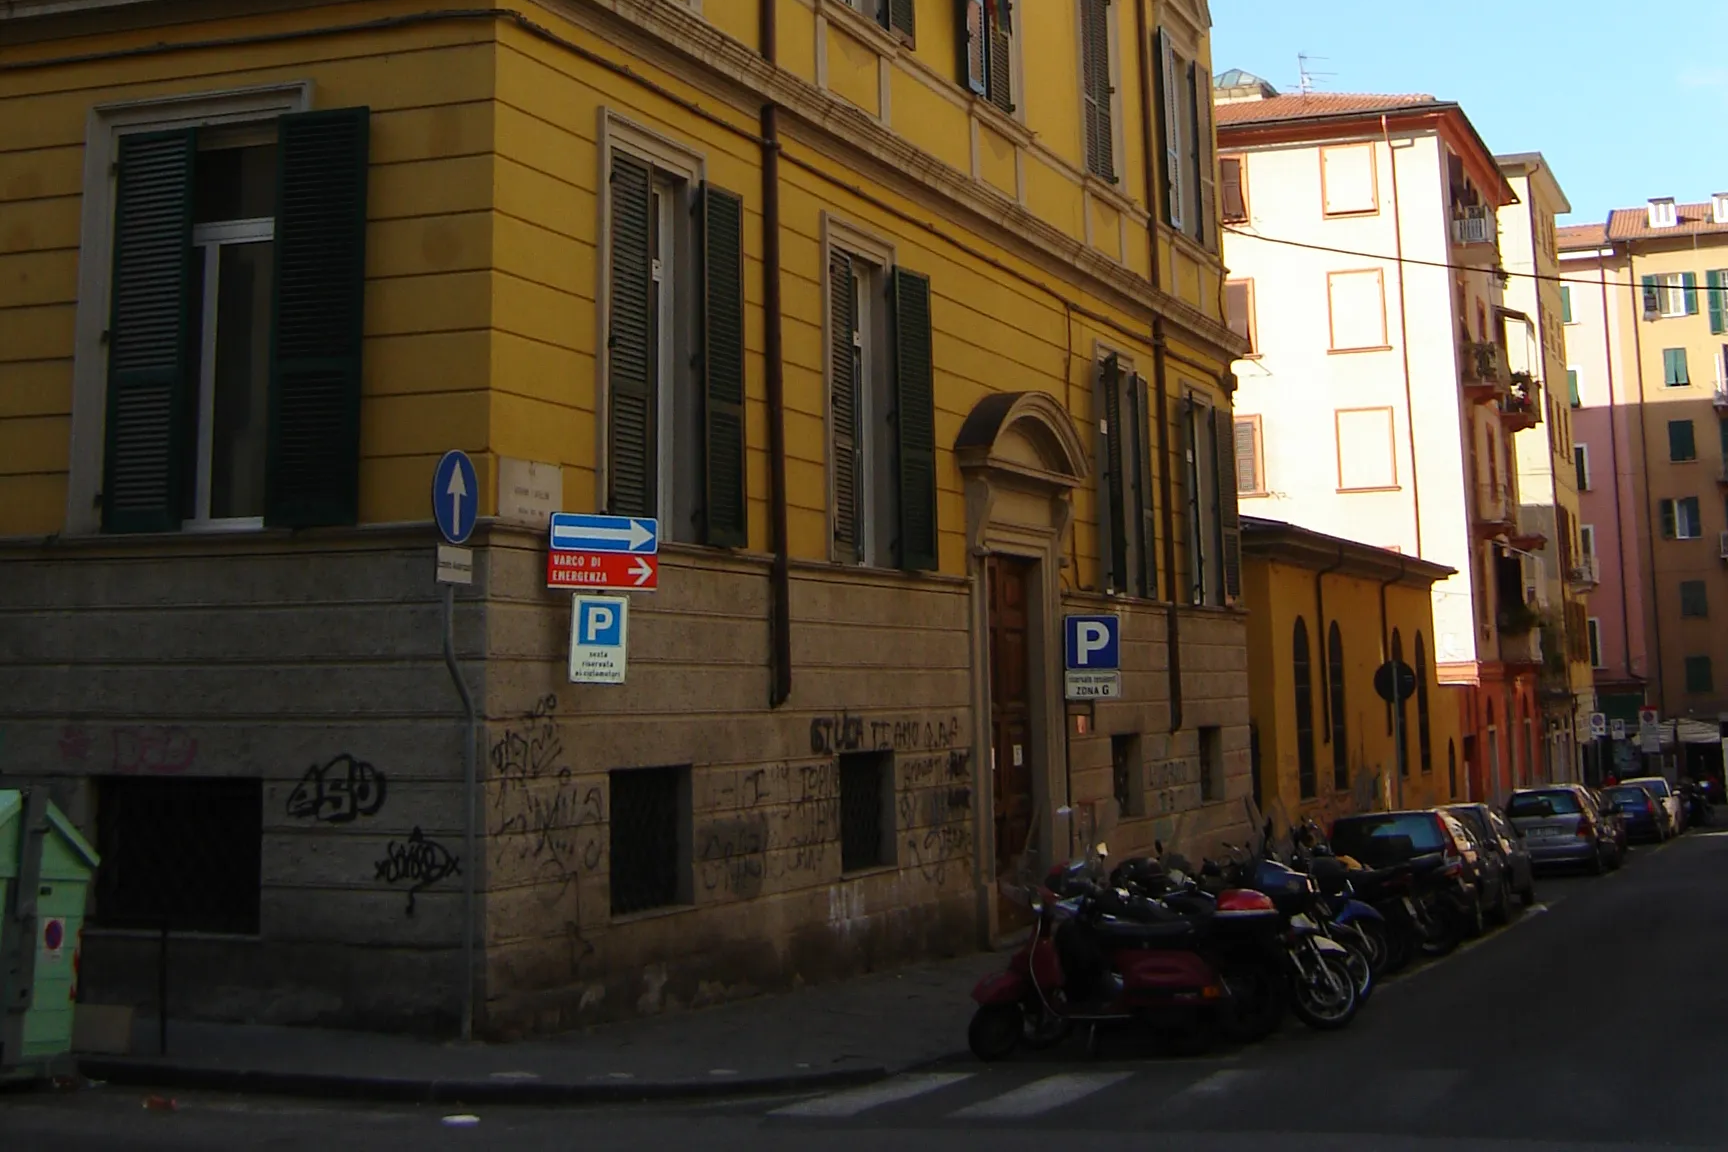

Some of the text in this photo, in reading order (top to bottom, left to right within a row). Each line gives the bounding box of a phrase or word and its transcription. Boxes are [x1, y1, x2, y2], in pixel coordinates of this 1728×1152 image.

[553, 554, 602, 567] VARCO DI
[552, 569, 608, 583] EMERGENZA
[587, 606, 614, 641] P
[1076, 620, 1110, 665] P
[1076, 684, 1109, 695] ZONA G
